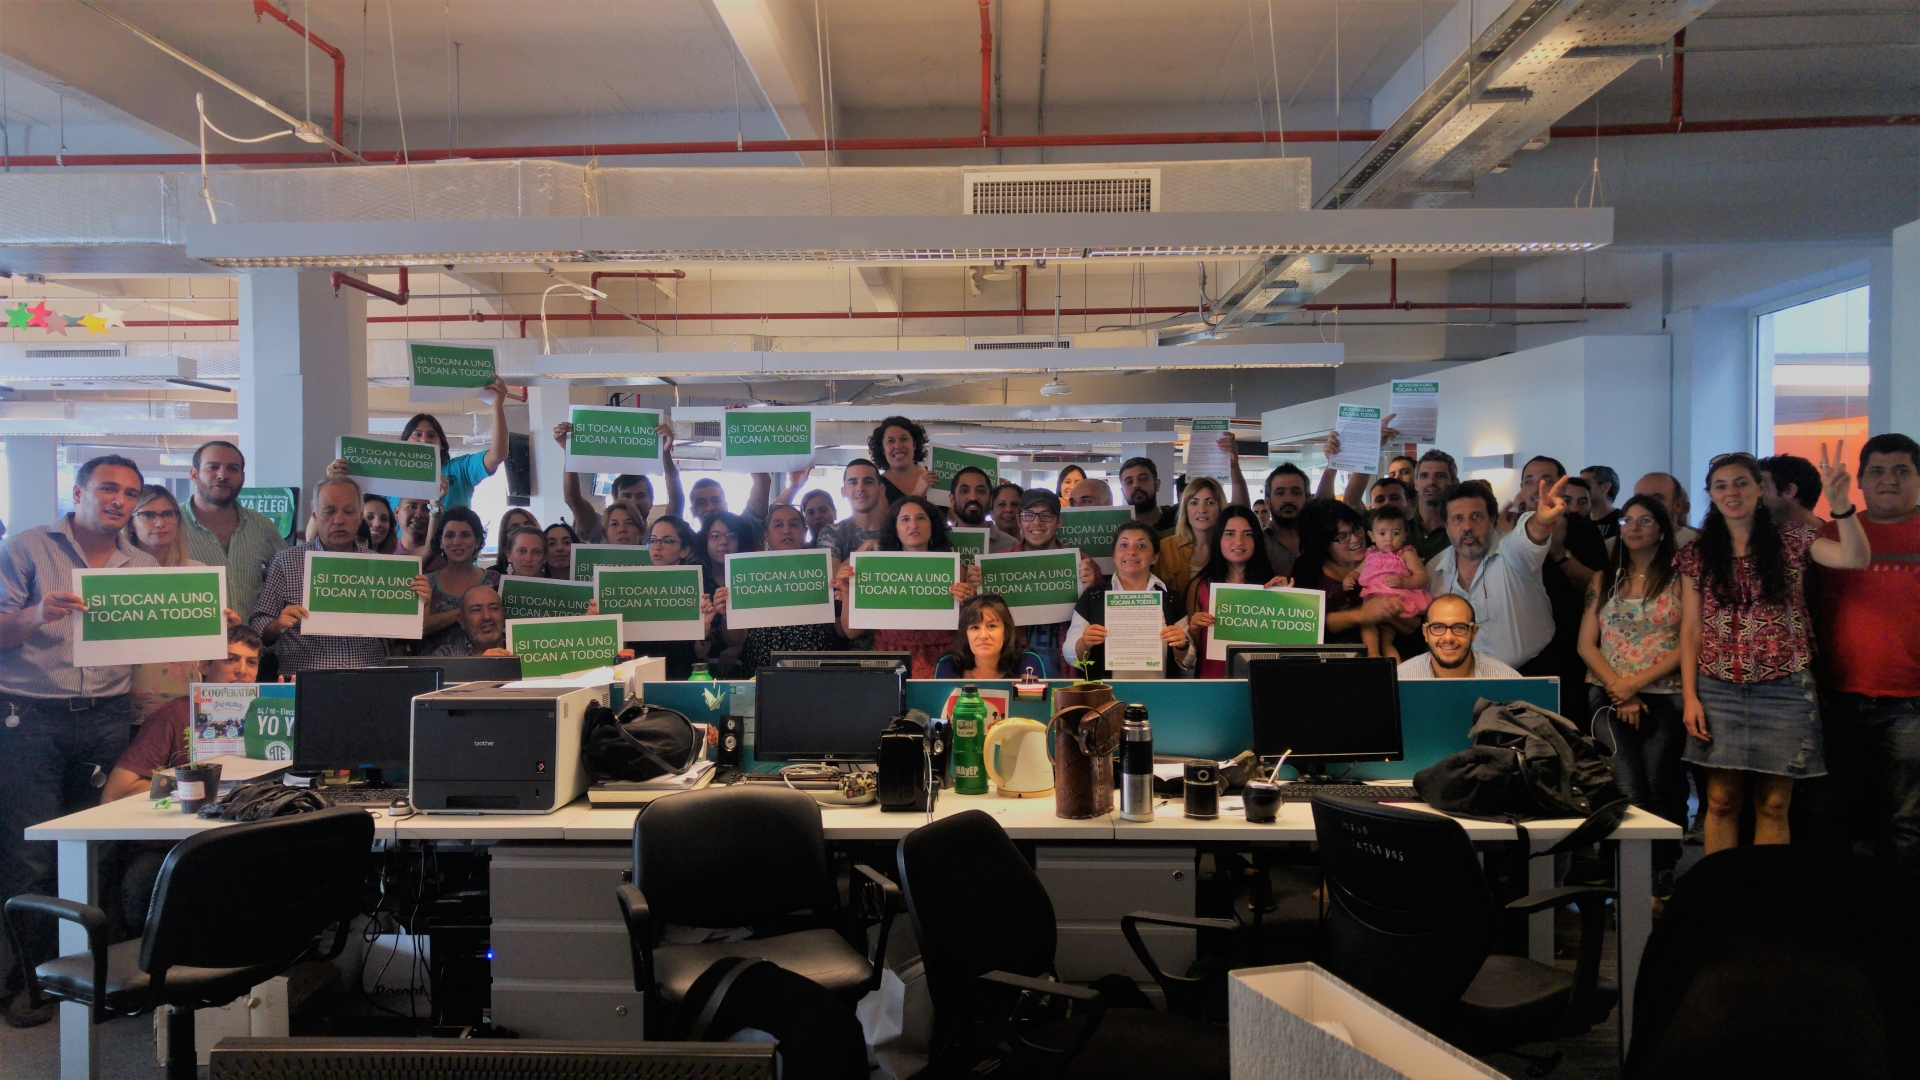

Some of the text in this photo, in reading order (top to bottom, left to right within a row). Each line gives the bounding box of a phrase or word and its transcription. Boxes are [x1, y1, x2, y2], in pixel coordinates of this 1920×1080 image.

[415, 357, 426, 365] ¡SI
[429, 358, 460, 366] TOCAN
[471, 361, 494, 369] UNO,
[416, 366, 449, 375] TOCAN
[574, 424, 657, 436] ¡SI TOCAN A UNO,
[728, 425, 739, 435] ¡SI
[742, 425, 775, 433] TOCAN
[786, 424, 809, 433] UNO,
[574, 435, 608, 444] TOCAN
[619, 437, 655, 446] TODOS!
[729, 436, 761, 444] TOCAN
[344, 447, 356, 455] ¡SI
[360, 448, 396, 457] TOCAN
[408, 453, 434, 461] UNO,
[345, 456, 381, 465] TOCAN
[393, 459, 433, 470] TODOS!
[934, 460, 943, 468] ¡SI
[945, 462, 969, 470] TOCA
[241, 500, 254, 509] YA
[1061, 525, 1095, 534] TOCAN
[1097, 525, 1104, 533] A
[1084, 537, 1090, 545] A
[578, 563, 590, 573] ¡SI
[314, 574, 328, 585] ¡SI
[332, 574, 374, 585] TOCAN
[377, 577, 385, 586] A
[733, 569, 826, 584] ¡SI TOCAN A UNO,
[858, 573, 952, 584] ¡SI TOCAN A UNO,
[984, 569, 1075, 584] ¡SI TOCAN A UNO,
[314, 587, 415, 600] TOCAN A TODOS!
[602, 586, 697, 598] ¡SI TOCAN A UNO,
[734, 581, 825, 595] TOCAN A TODOS!
[859, 585, 897, 595] TOCAN
[899, 586, 907, 595] A
[985, 581, 1074, 594] TOCAN A TODOS!
[87, 592, 217, 609] ¡SI TOCAN A UNO,
[504, 595, 516, 605] ¡SI
[520, 596, 556, 607] TOCAN
[558, 600, 565, 608] A
[602, 598, 696, 608] TOCAN A TODOS!
[88, 607, 216, 623] TOCAN A TODOS!
[506, 607, 540, 617] TOCAN
[1218, 604, 1317, 620] ¡SI TOCAN A UNO,
[1218, 616, 1315, 632] TOCAN A TODOS!
[515, 636, 615, 652] ¡SI TOCAN A UNO,
[518, 649, 615, 662] TOCAN A TODOS!
[258, 716, 279, 736] YO
[269, 745, 286, 760] ATE
